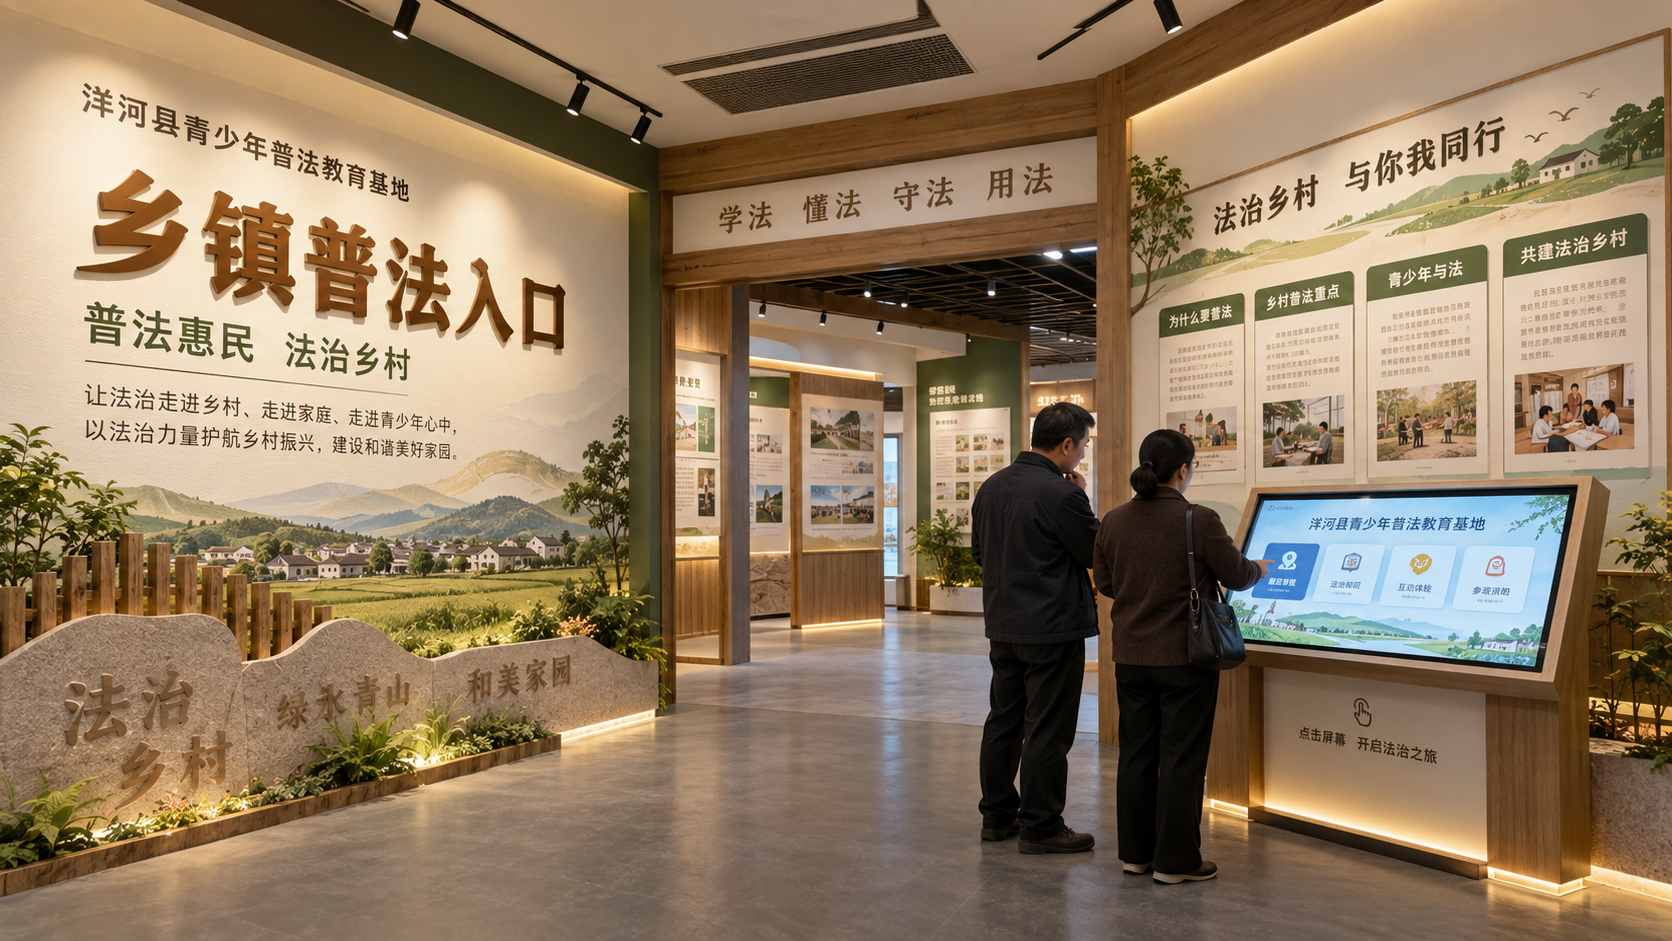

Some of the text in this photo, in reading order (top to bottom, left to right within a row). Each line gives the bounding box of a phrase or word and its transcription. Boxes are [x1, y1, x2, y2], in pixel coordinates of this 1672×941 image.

[82, 83, 410, 202] 洋河县青少年普法教育基地
[719, 163, 1053, 234] 学法 懂法 守法 用法
[1213, 116, 1505, 235] 法治乡村 与你我同行
[75, 168, 566, 350] 乡镇普法入口
[1388, 260, 1463, 289] 青少年与法
[1520, 228, 1628, 265] 共建法治乡村
[1266, 284, 1340, 311] 乡村普法重点
[84, 301, 411, 381] 普法惠民 法治乡村
[1308, 516, 1486, 531] 洋河县青少年普法教育基地
[65, 670, 194, 746] 法治
[276, 673, 411, 730] 绿水青山
[467, 655, 572, 702] 和美家园
[114, 730, 233, 811] 乡村
[1299, 727, 1438, 764] 点击屏幕 开启法治之旅
